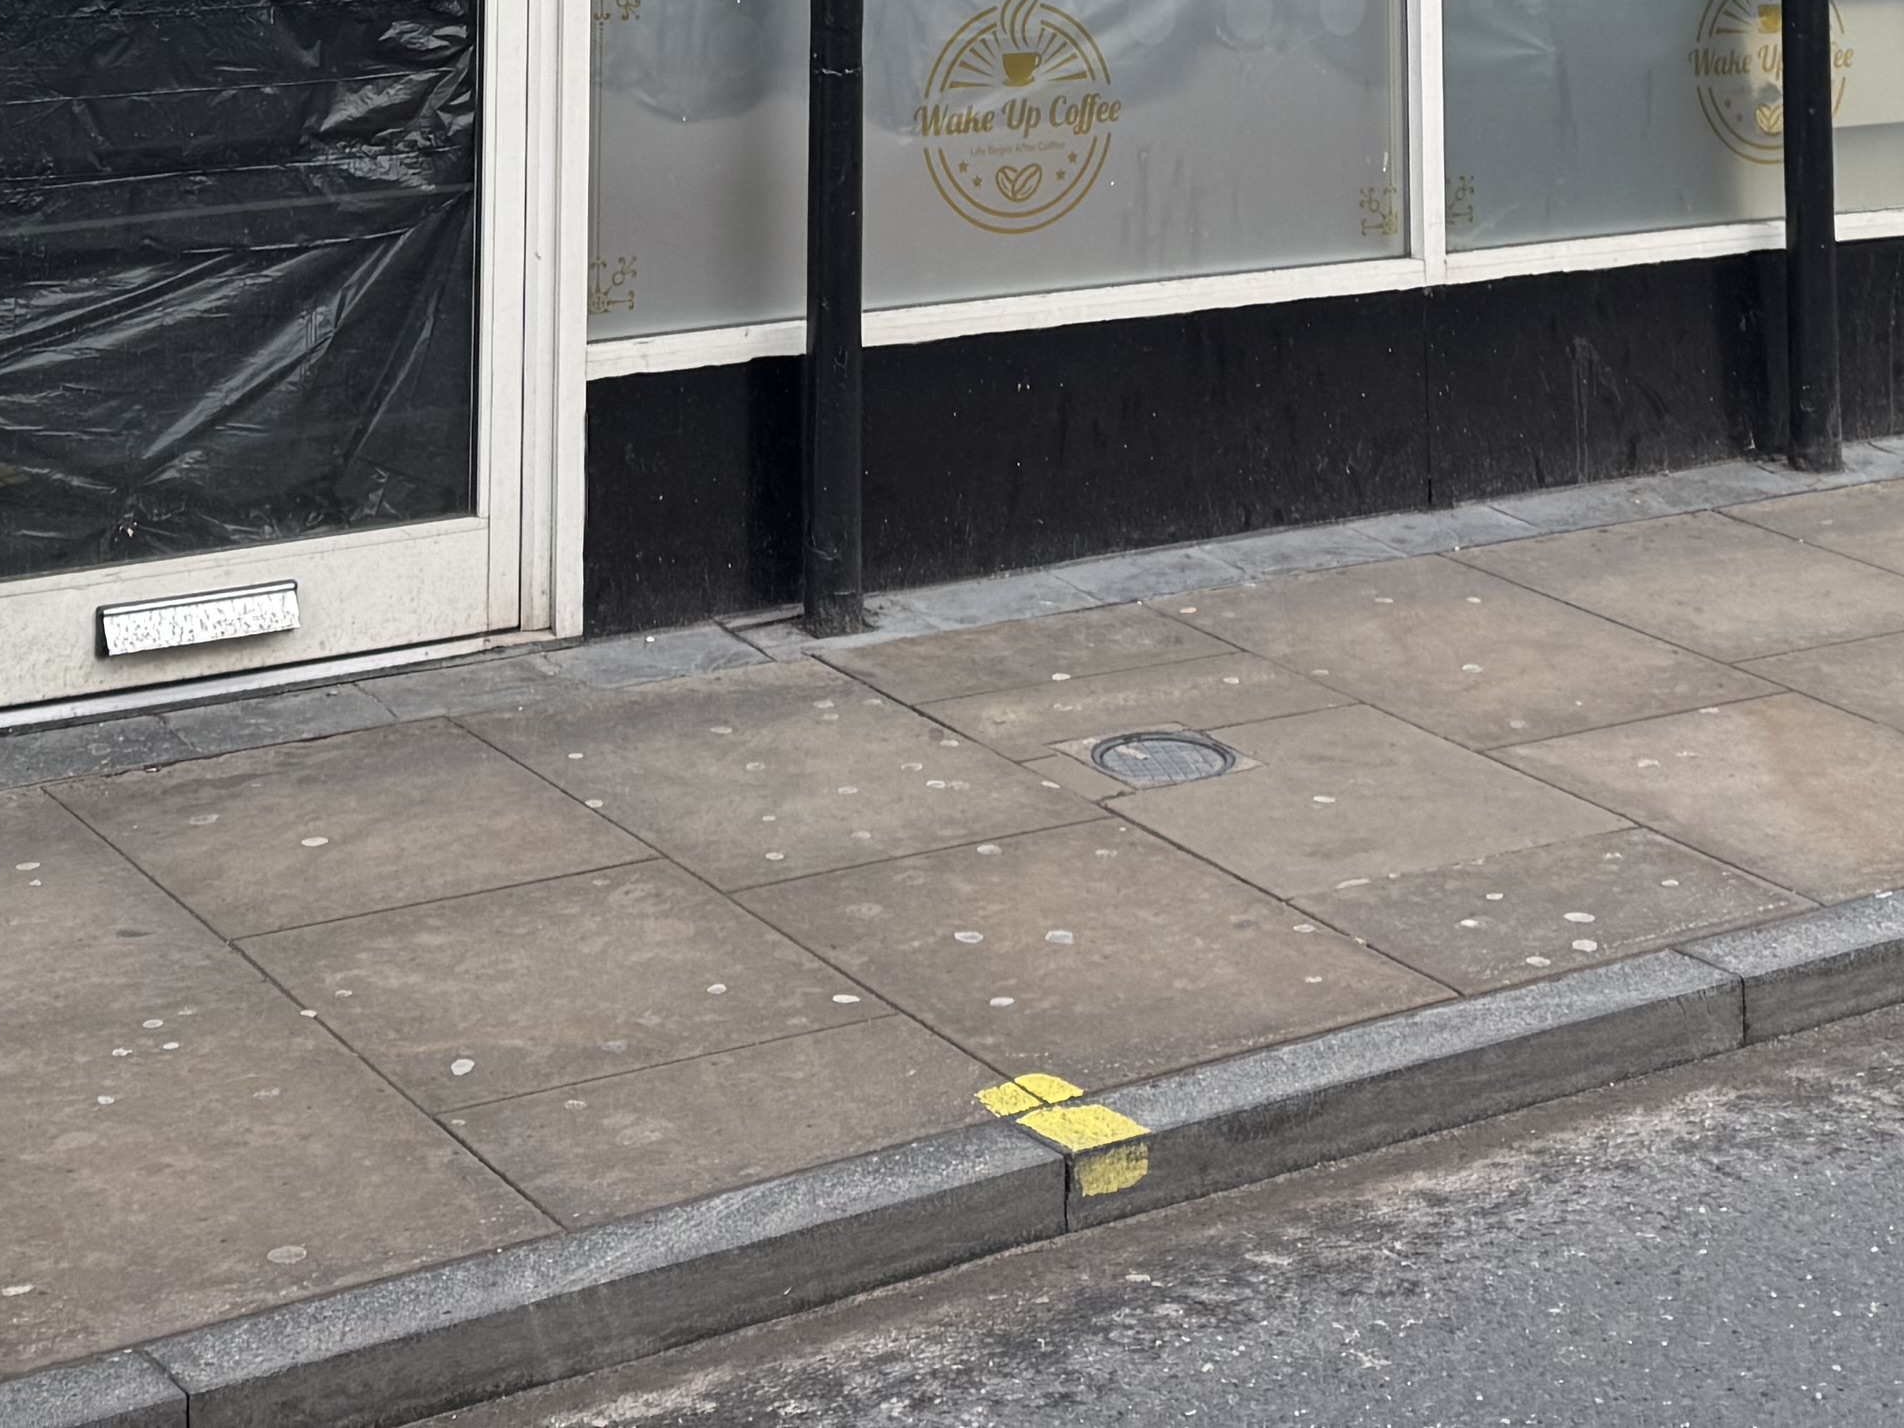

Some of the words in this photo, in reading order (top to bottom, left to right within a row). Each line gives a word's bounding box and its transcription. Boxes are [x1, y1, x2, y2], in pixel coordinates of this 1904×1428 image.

[1688, 46, 1753, 77] Wake
[913, 103, 995, 137] Wake
[1001, 97, 1042, 139] Up
[1049, 92, 1122, 136] Coffee
